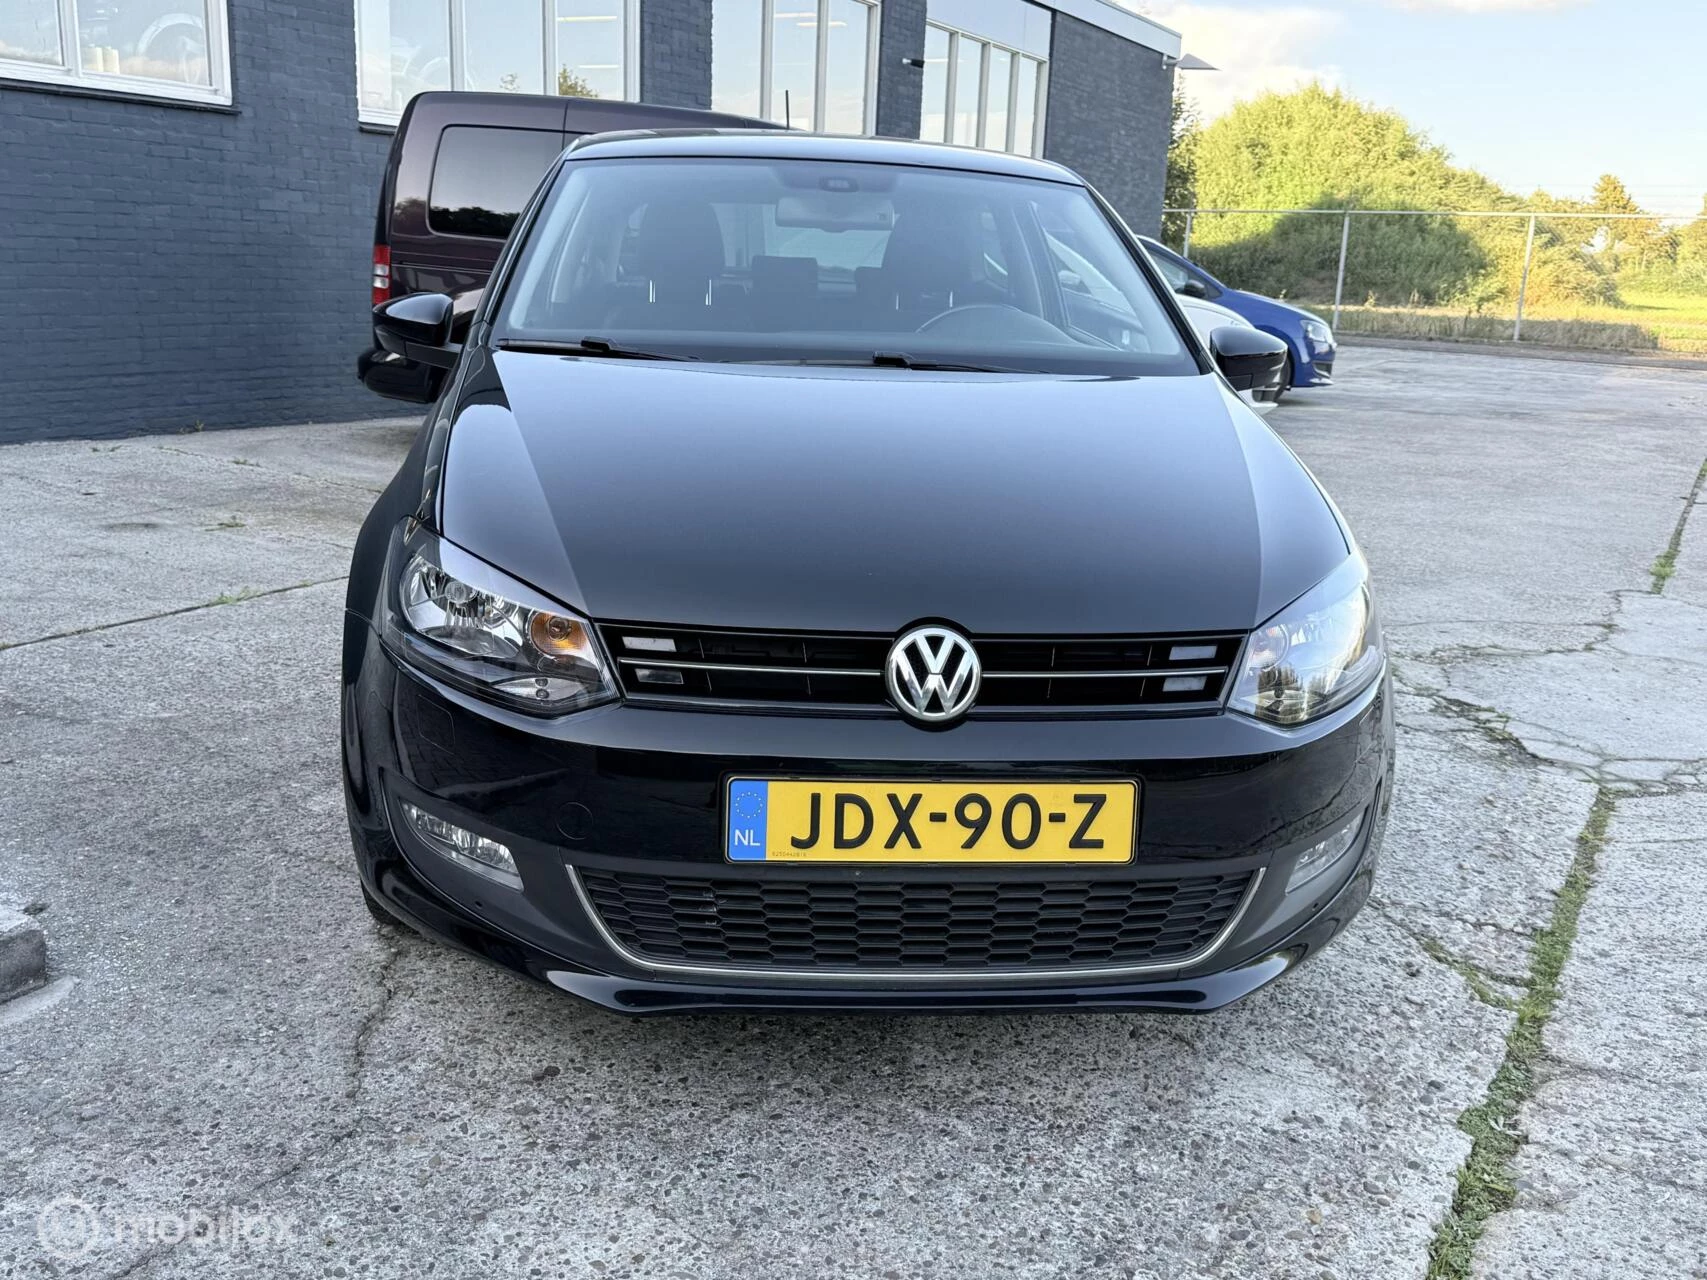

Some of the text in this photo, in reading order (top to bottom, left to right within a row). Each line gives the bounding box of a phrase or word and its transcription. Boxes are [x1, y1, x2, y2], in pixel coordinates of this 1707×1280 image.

[888, 628, 980, 718] VW
[734, 829, 761, 847] NL
[790, 792, 1107, 850] JDX-90-Z
